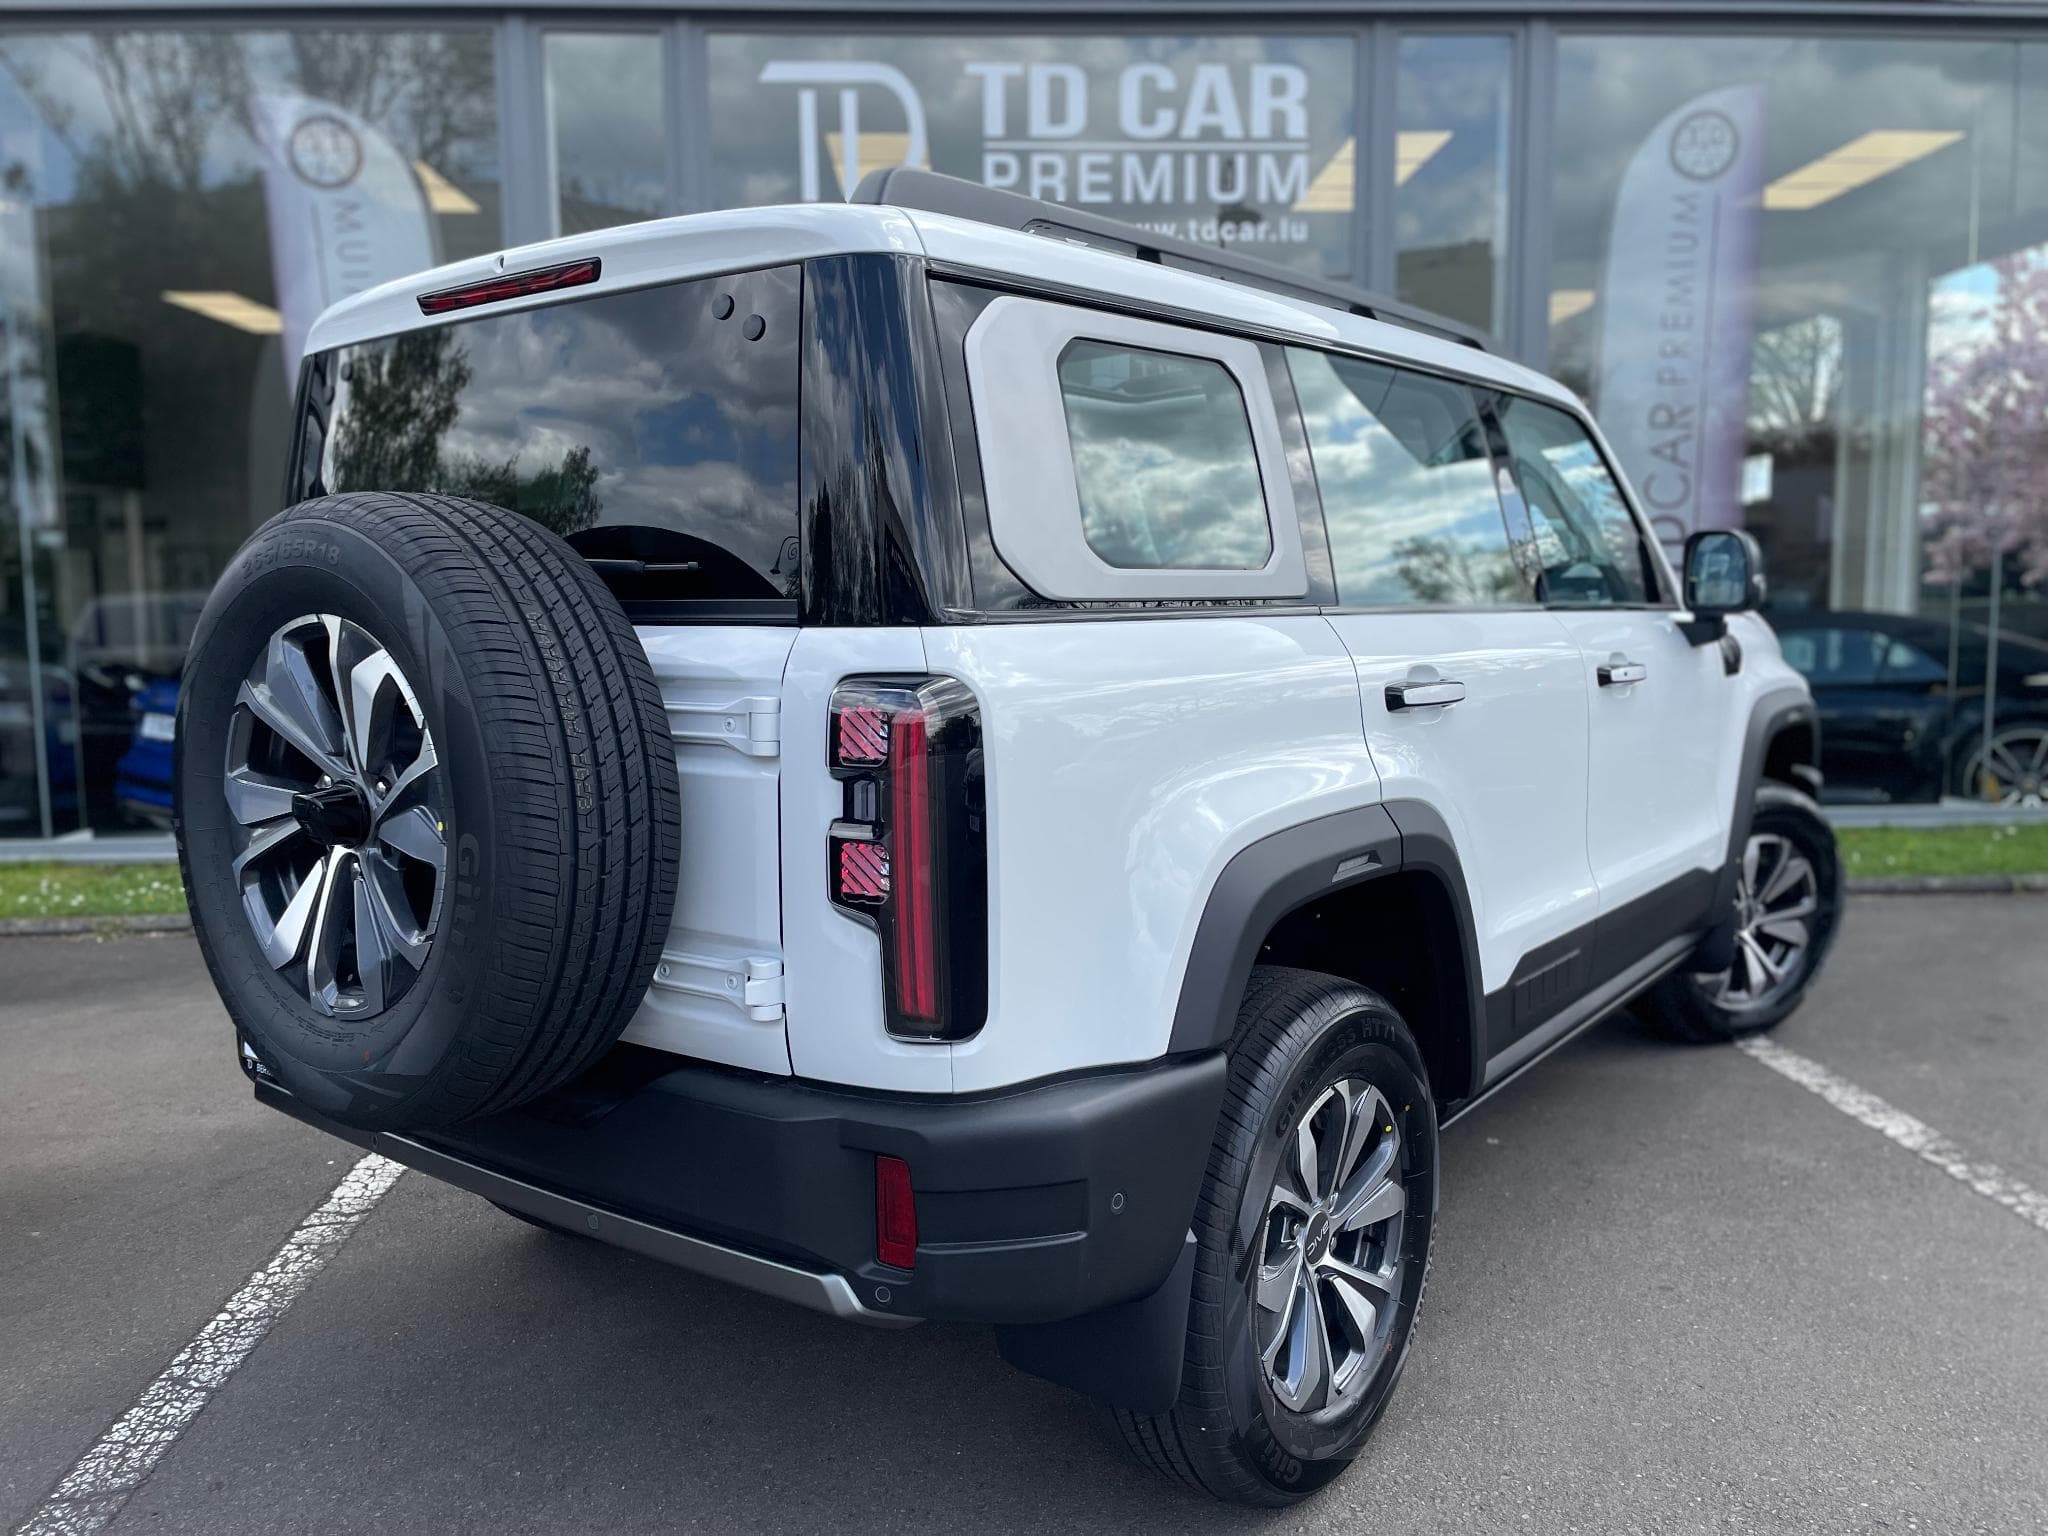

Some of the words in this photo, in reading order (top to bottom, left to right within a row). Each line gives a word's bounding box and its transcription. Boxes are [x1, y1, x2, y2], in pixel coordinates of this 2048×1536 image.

[964, 62, 1089, 139] TD
[1119, 62, 1309, 139] CAR
[983, 152, 1309, 204] PREMIUM
[1656, 193, 1700, 387] PREMIUM
[1643, 402, 1697, 572] DCAR
[1306, 1220, 1329, 1257] BAIC
